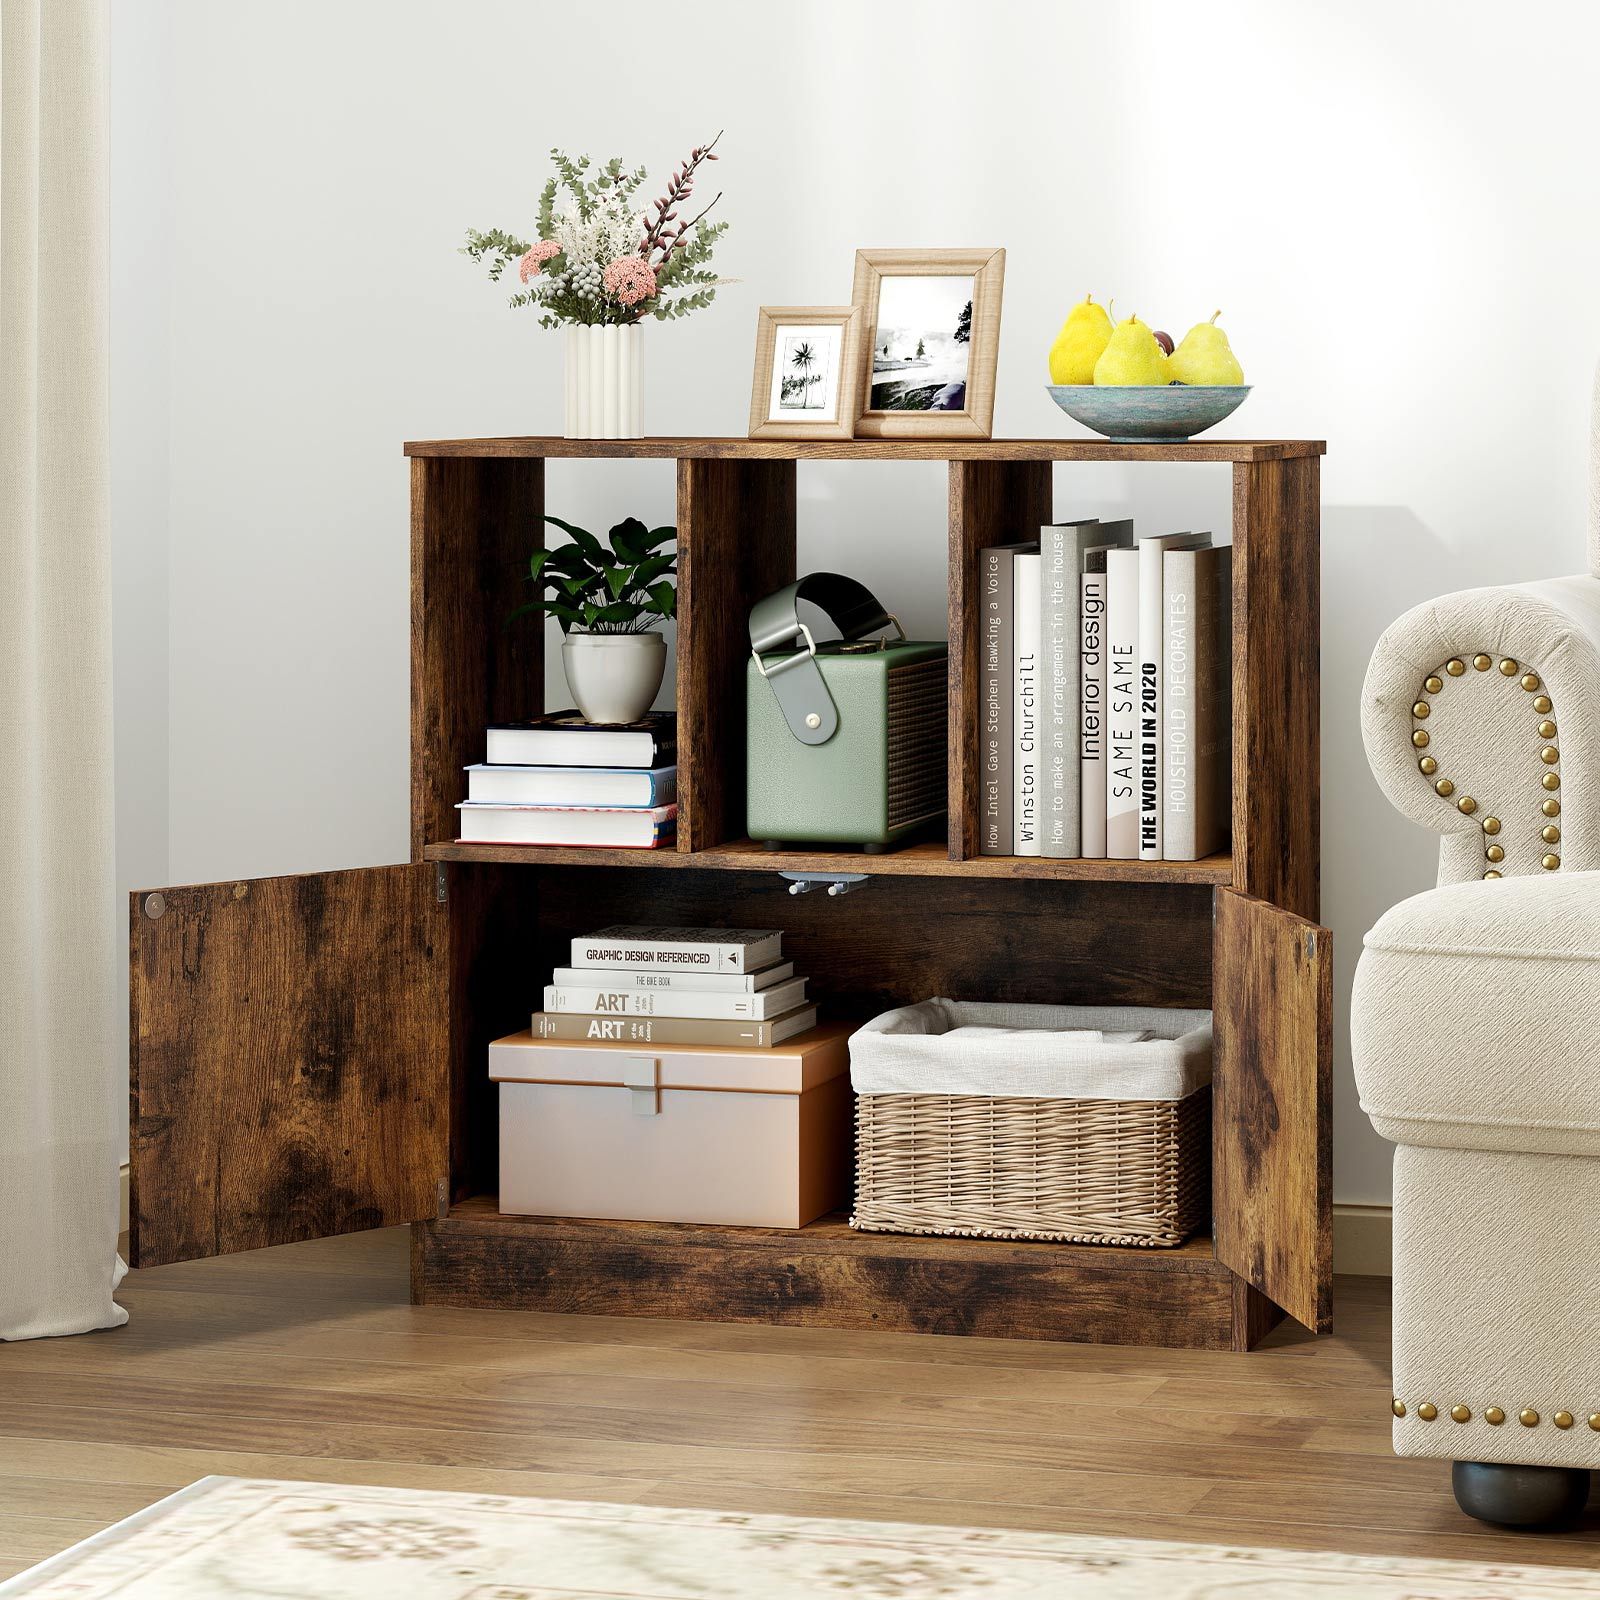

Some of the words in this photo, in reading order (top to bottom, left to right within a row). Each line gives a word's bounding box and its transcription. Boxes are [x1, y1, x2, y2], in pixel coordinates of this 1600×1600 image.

[1052, 534, 1064, 573] house
[988, 556, 998, 594] Voice
[1052, 581, 1063, 604] the
[1052, 614, 1063, 629] in
[1081, 584, 1104, 665] design
[988, 618, 1000, 671] Hawking
[1171, 593, 1186, 696] DECORATES
[1053, 637, 1066, 725] arrangement
[1113, 645, 1132, 712] SAME
[1142, 663, 1156, 713] 2020
[987, 679, 1000, 732] Stephen
[1020, 653, 1034, 752] Churchill
[1081, 673, 1099, 760] Interior
[1055, 733, 1063, 748] an
[1142, 719, 1156, 737] IN
[988, 741, 998, 771] Gave
[1052, 757, 1063, 788] make
[1113, 730, 1132, 798] SAME
[1171, 709, 1186, 812] HOUSEHOLD
[1142, 743, 1156, 811] WORLD
[988, 780, 998, 816] Intel
[1020, 764, 1034, 841] Winston
[1053, 796, 1064, 811] to
[988, 825, 998, 848] How
[1052, 820, 1063, 844] How
[1142, 817, 1156, 851] THE
[586, 949, 623, 962] GRAPHIC
[624, 951, 655, 963] DESIGN
[657, 952, 710, 964] REFERENCED
[636, 976, 646, 986] THE
[647, 976, 657, 986] BIKE
[658, 977, 671, 987] BOOK
[595, 993, 629, 1012] ART
[587, 1020, 625, 1038] ART
